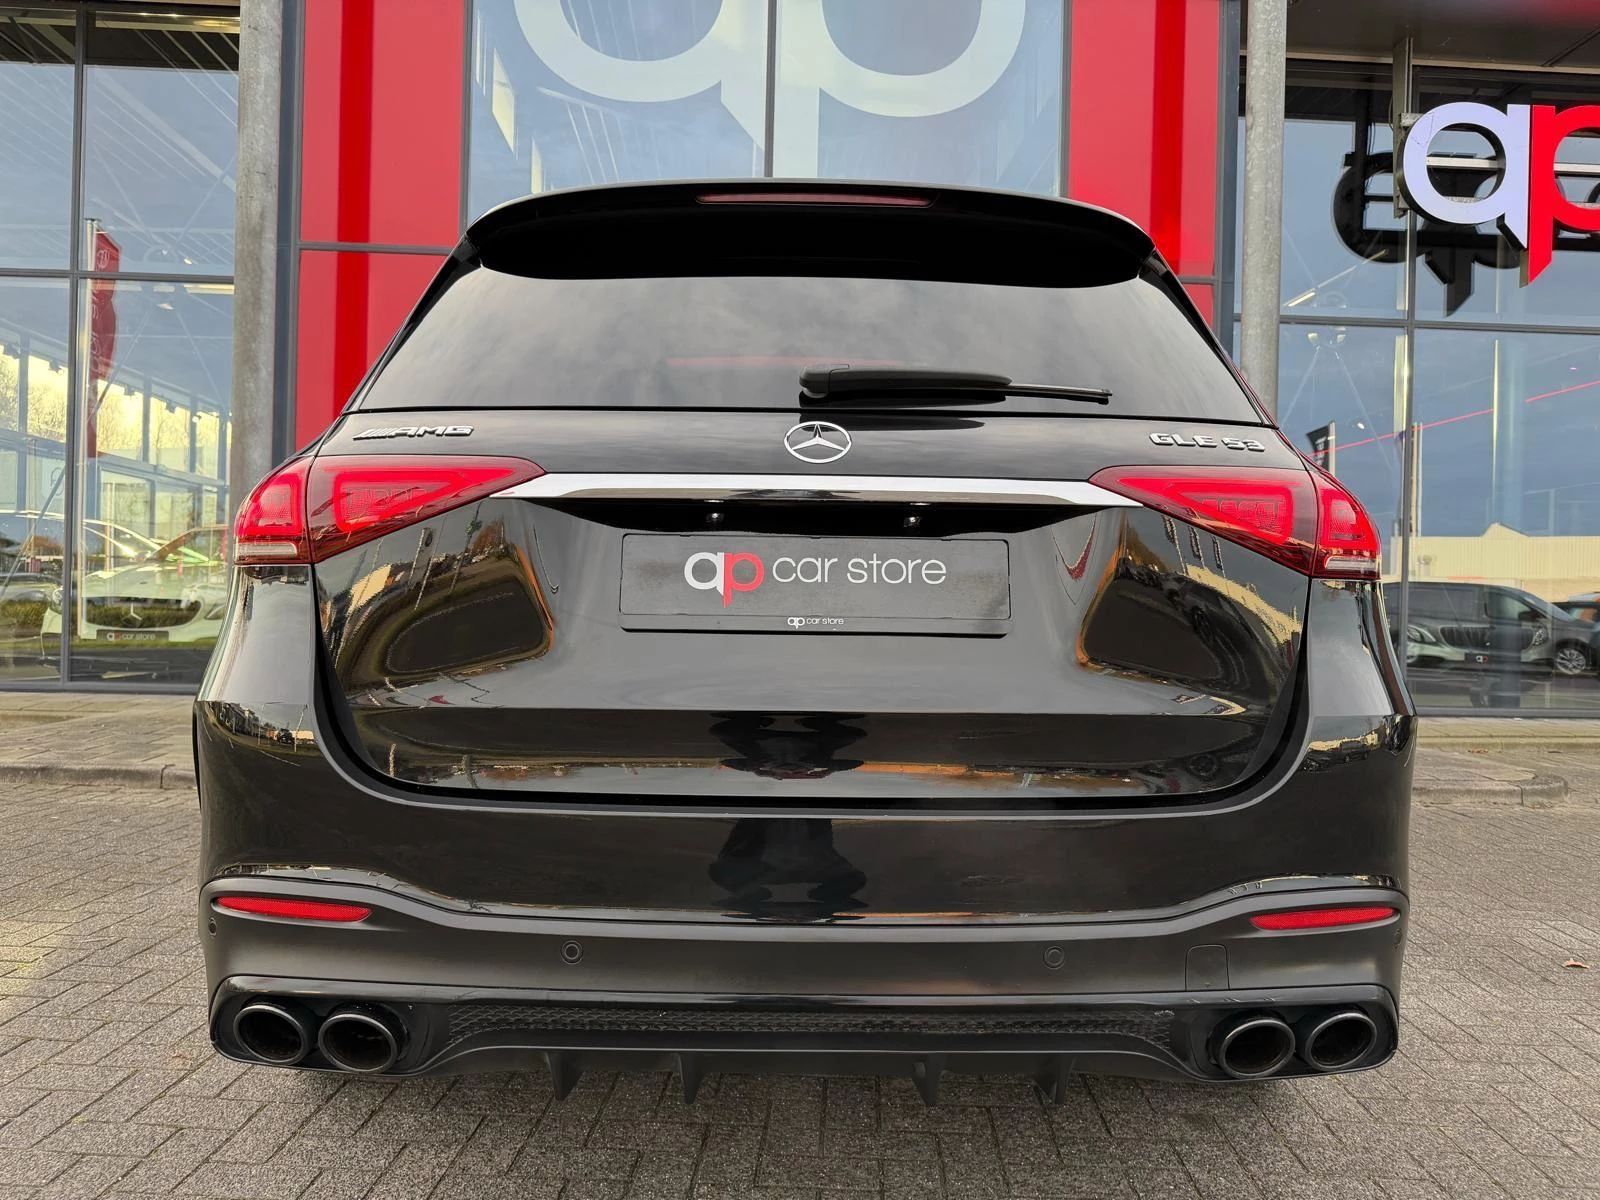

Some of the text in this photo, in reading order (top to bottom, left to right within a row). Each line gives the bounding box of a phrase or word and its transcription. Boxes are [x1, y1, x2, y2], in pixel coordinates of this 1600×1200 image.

[1149, 432, 1265, 452] GLE 53
[684, 551, 947, 608] ap car store
[806, 617, 821, 625] car
[822, 617, 845, 625] store
[122, 633, 134, 641] car
[135, 632, 156, 641] store
